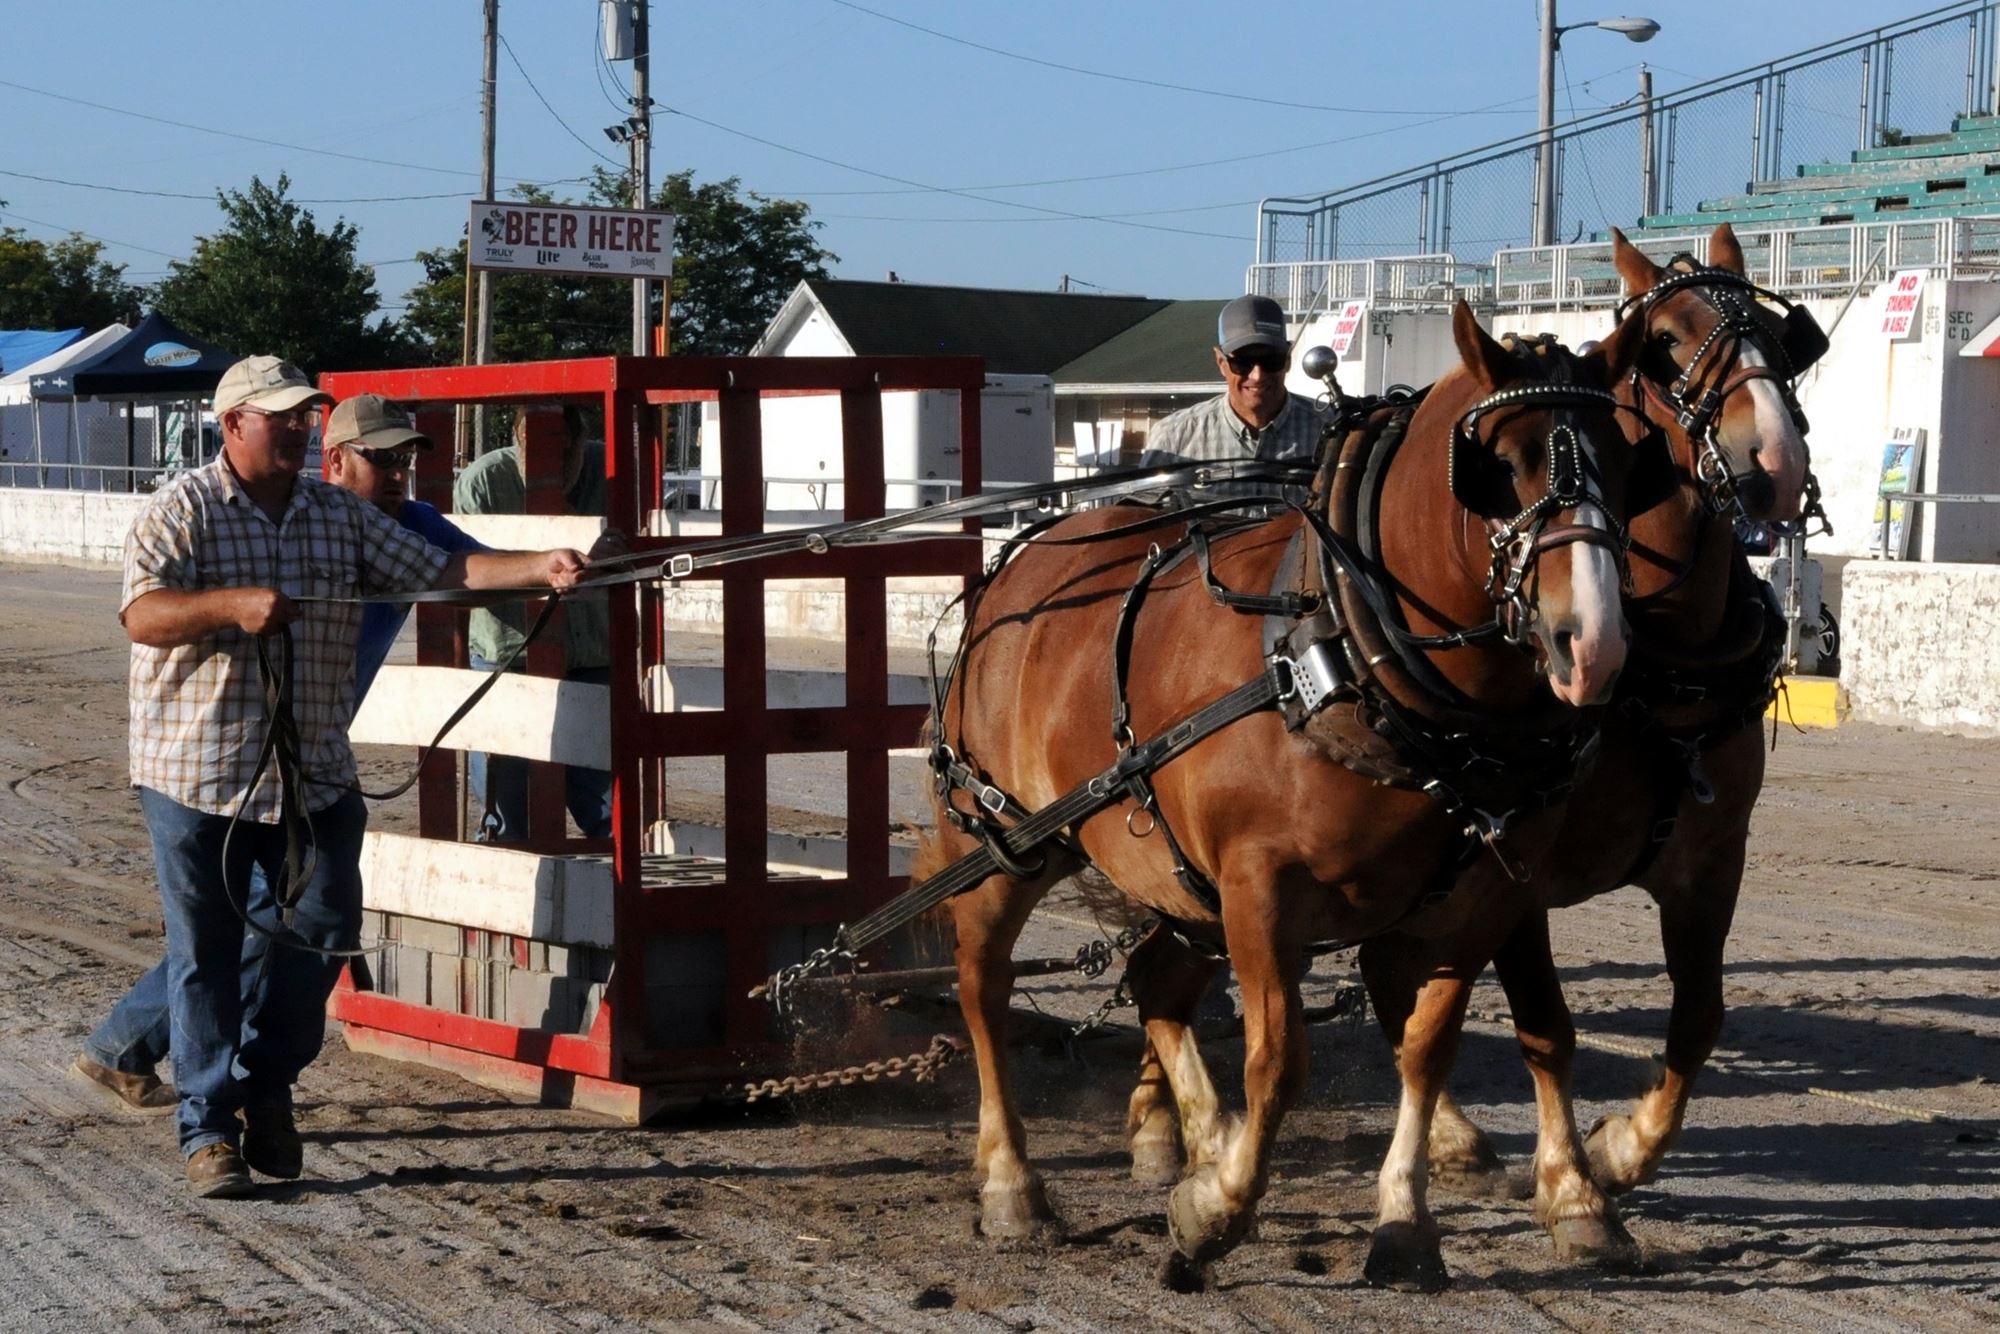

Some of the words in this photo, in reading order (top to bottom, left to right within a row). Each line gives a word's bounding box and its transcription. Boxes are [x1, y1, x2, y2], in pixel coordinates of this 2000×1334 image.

[505, 210, 578, 249] BEER
[588, 215, 662, 253] HERE
[485, 248, 514, 257] TRULY
[536, 250, 560, 265] Lite
[1898, 275, 1917, 291] NO
[1885, 295, 1917, 312] STANDING
[1344, 305, 1359, 318] NO
[1948, 310, 1974, 324] SEC
[1890, 316, 1909, 333] AISLE
